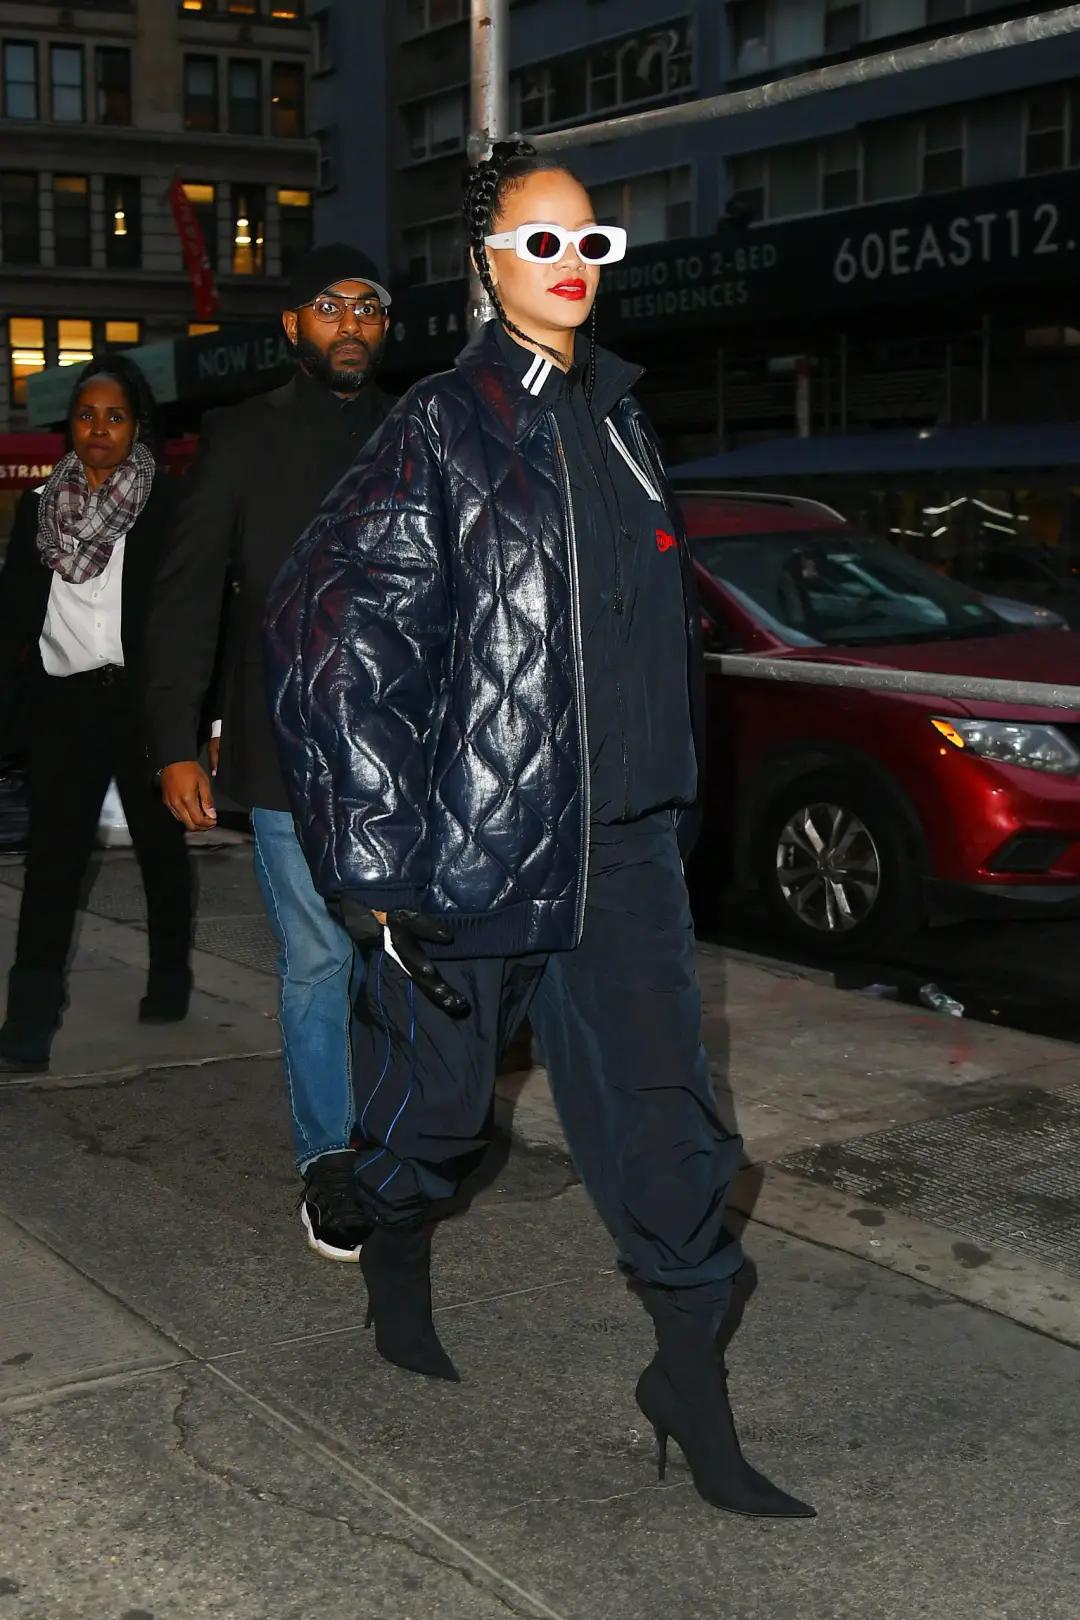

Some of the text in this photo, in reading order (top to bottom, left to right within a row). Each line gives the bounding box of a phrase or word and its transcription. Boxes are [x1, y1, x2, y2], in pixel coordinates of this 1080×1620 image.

[603, 243, 777, 292] TUDIO TO 2-BED
[620, 280, 750, 319] RESIDENCES
[197, 341, 249, 378] NOW
